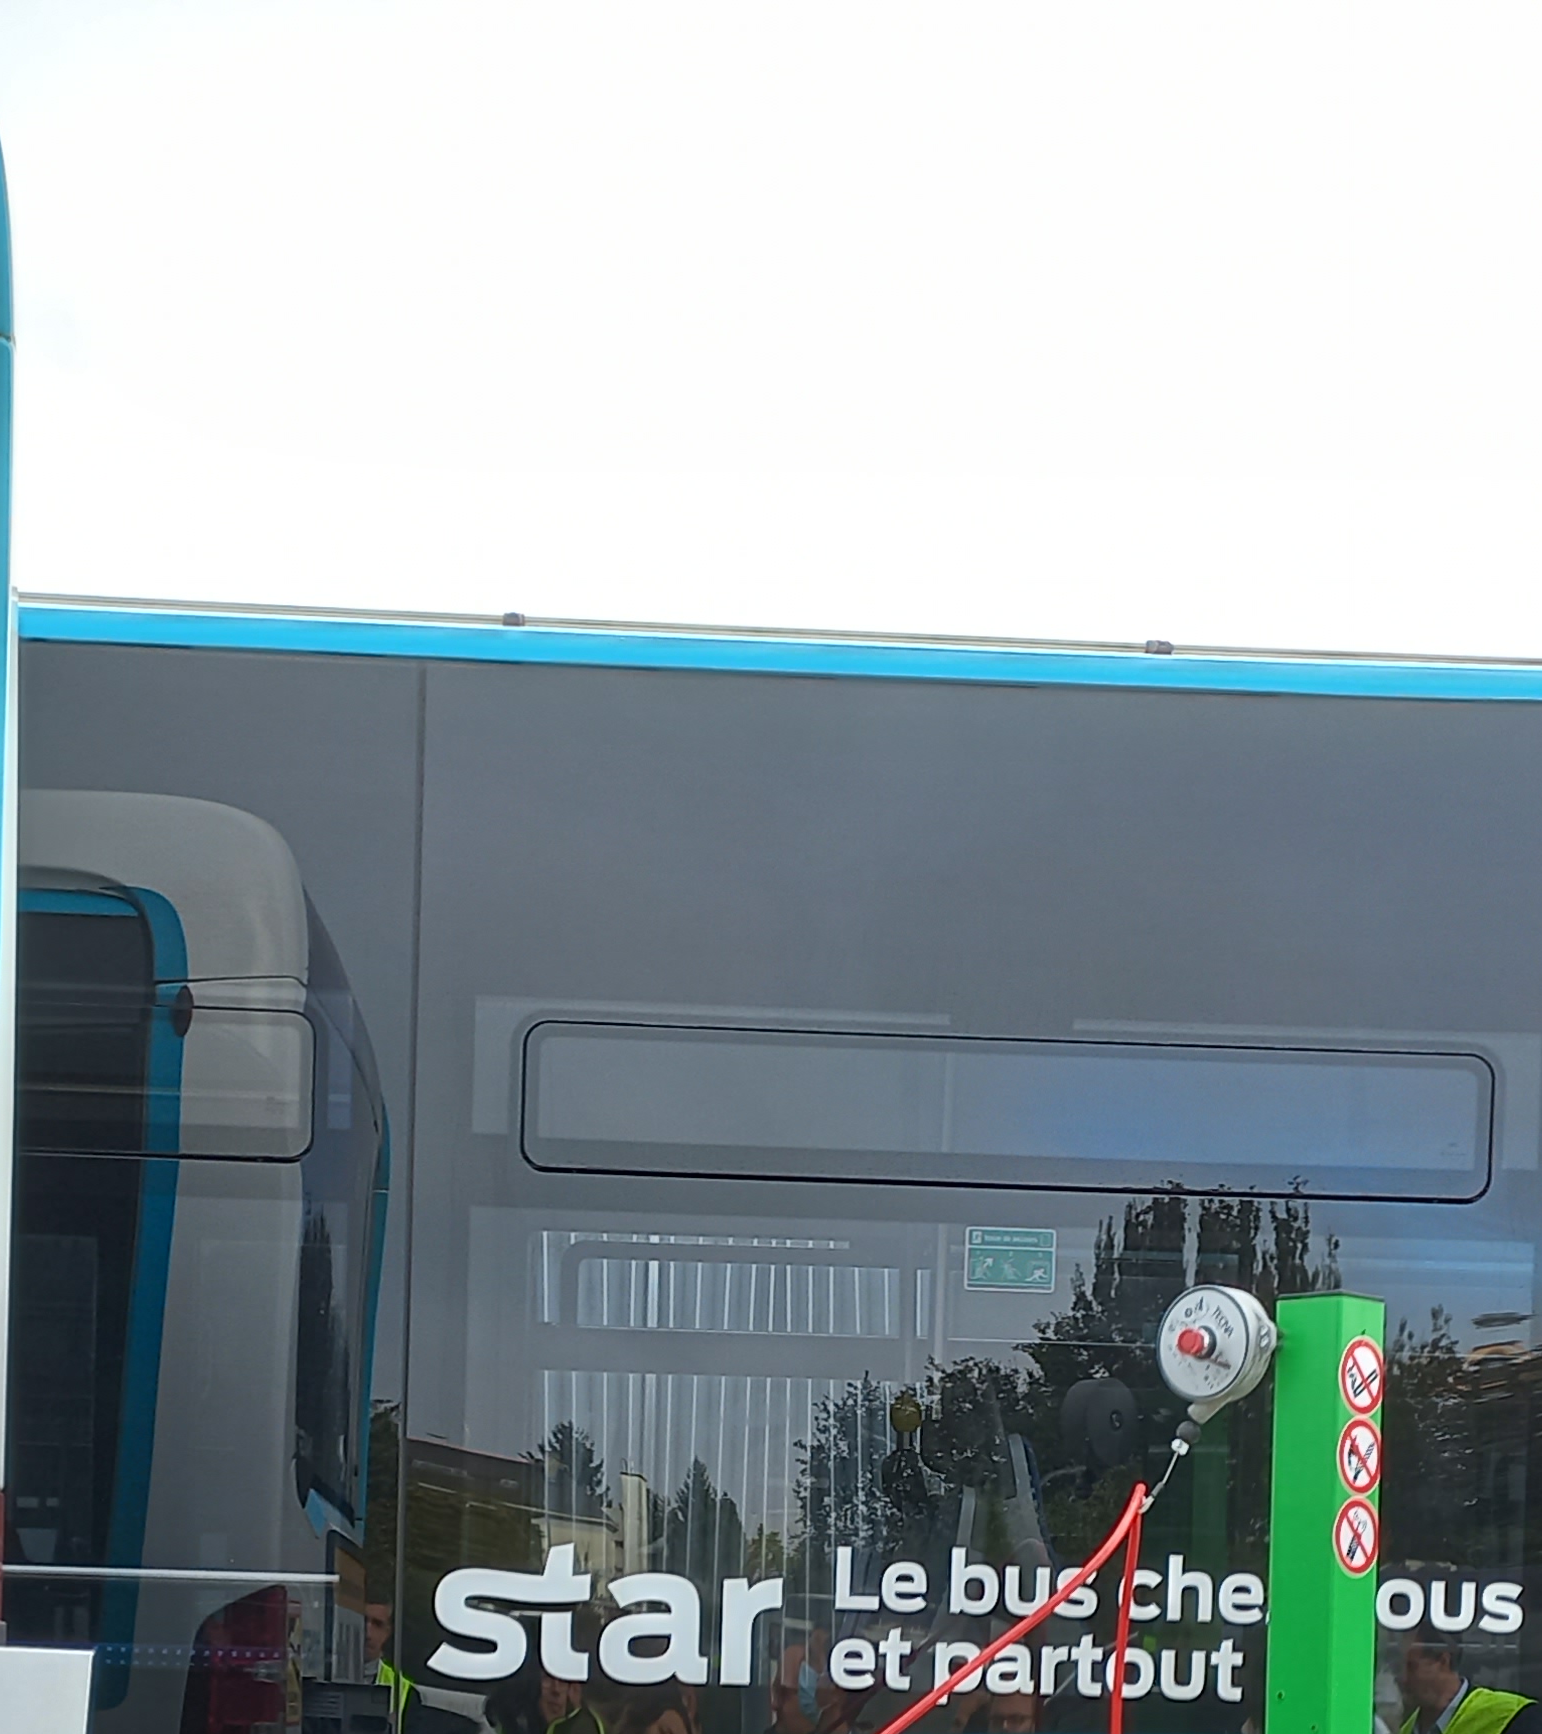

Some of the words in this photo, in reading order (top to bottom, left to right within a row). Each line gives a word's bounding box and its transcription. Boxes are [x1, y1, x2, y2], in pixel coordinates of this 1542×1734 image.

[426, 1542, 784, 1687] star
[833, 1546, 928, 1613] Le
[949, 1546, 1098, 1620] bus
[1120, 1554, 1271, 1626] che
[1376, 1577, 1526, 1634] ous
[829, 1627, 912, 1692] et
[935, 1633, 1245, 1707] partout
